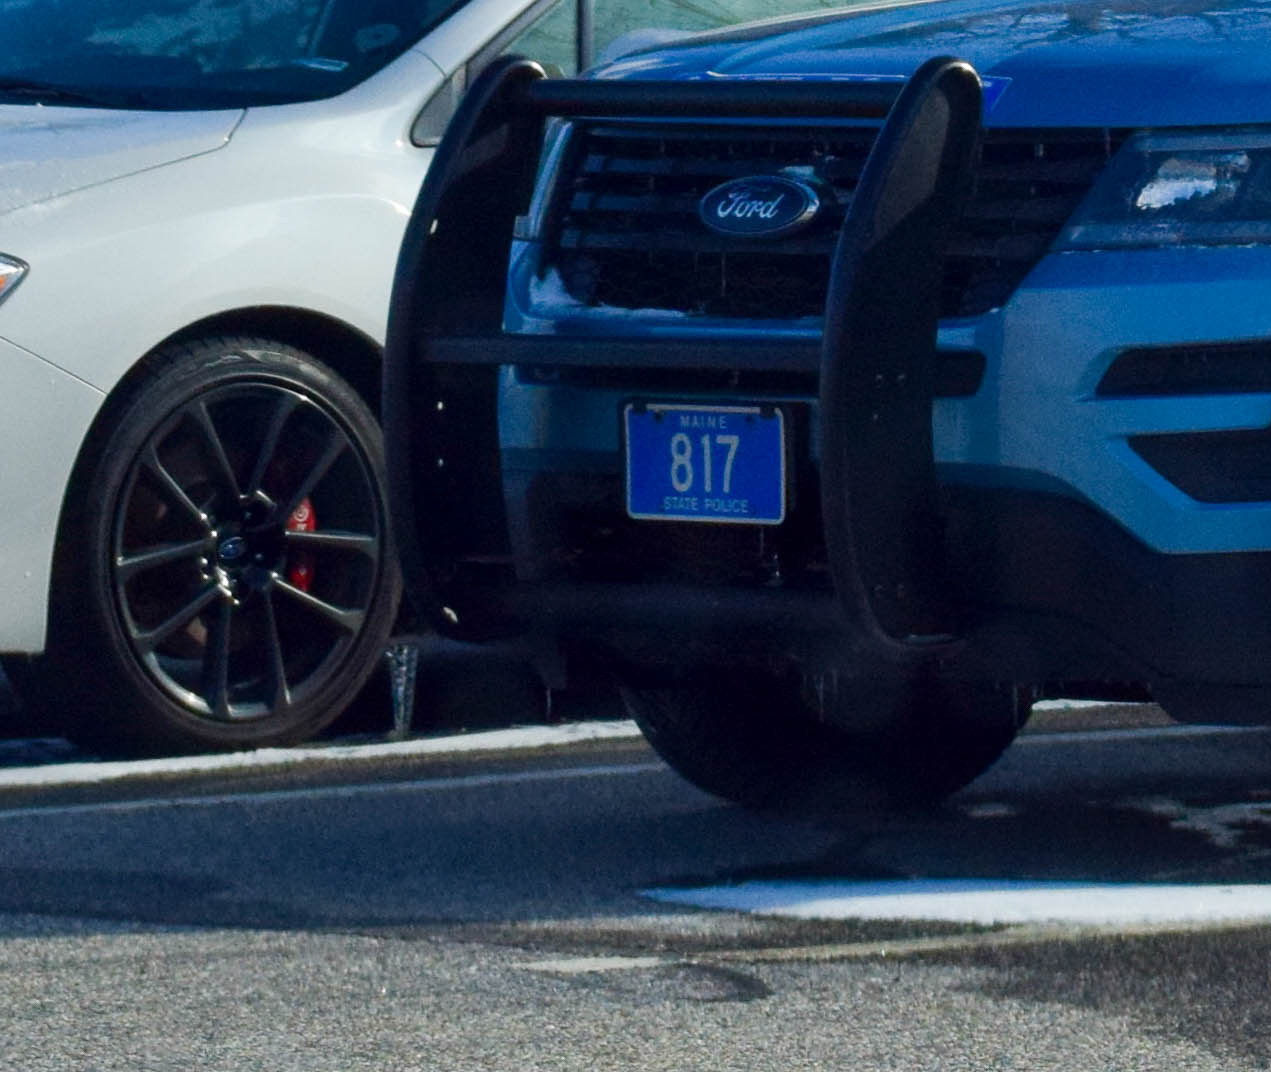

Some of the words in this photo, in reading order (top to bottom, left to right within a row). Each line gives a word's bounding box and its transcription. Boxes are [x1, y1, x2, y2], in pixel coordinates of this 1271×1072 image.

[716, 191, 785, 219] Ford
[679, 415, 728, 429] MAINE
[670, 432, 740, 493] 817
[662, 496, 699, 511] STATE
[704, 498, 749, 513] POLICE
